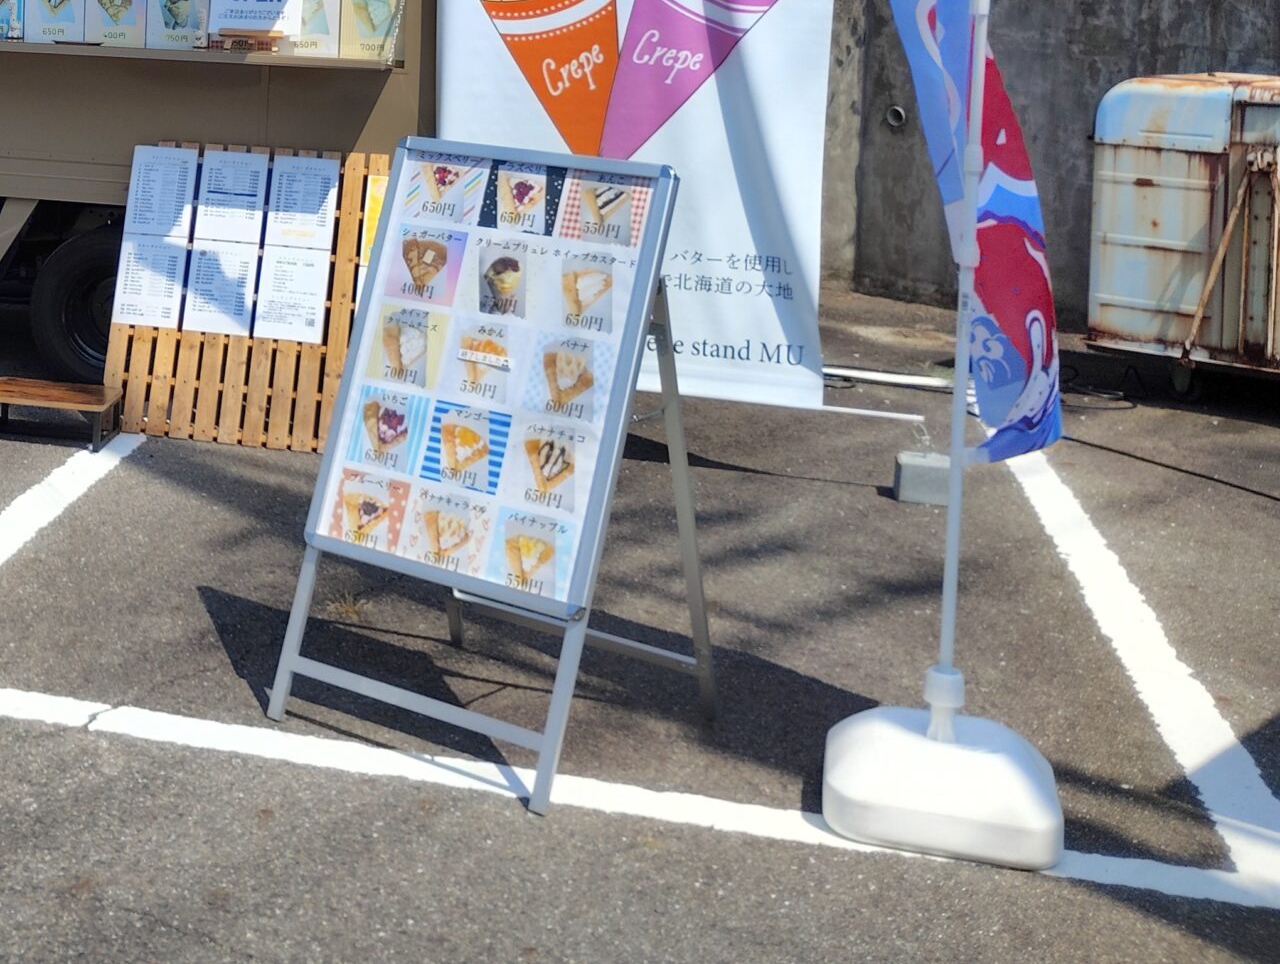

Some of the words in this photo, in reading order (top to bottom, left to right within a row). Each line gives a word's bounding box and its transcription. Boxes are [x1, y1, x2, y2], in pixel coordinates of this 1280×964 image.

[42, 28, 64, 36] 650円
[103, 31, 126, 40] 00円
[166, 34, 188, 43] 750円
[360, 43, 384, 52] 700円
[632, 28, 705, 84] Crepe
[541, 43, 605, 97] Crepe
[422, 201, 456, 217] 650円
[500, 211, 535, 228] 650円
[583, 222, 621, 239] 550円
[552, 249, 637, 268] ホイップカスタード
[669, 249, 794, 276] バターを使用し
[400, 282, 435, 299] 400円
[565, 313, 604, 331] 650円
[478, 325, 505, 338] みかん
[560, 339, 589, 349] バナナ
[691, 339, 751, 362] stand
[760, 342, 805, 366] MU
[384, 365, 418, 384] 700円
[459, 380, 497, 399] 550円
[382, 393, 408, 406] いちご
[545, 399, 584, 418] 600円
[454, 408, 491, 421] マンゴー
[527, 423, 586, 443] バナナチョコ
[364, 450, 398, 468] 650円
[441, 467, 477, 486] 650円
[524, 488, 563, 509] 650円
[424, 551, 460, 572] 650円
[505, 573, 544, 596] 550円
